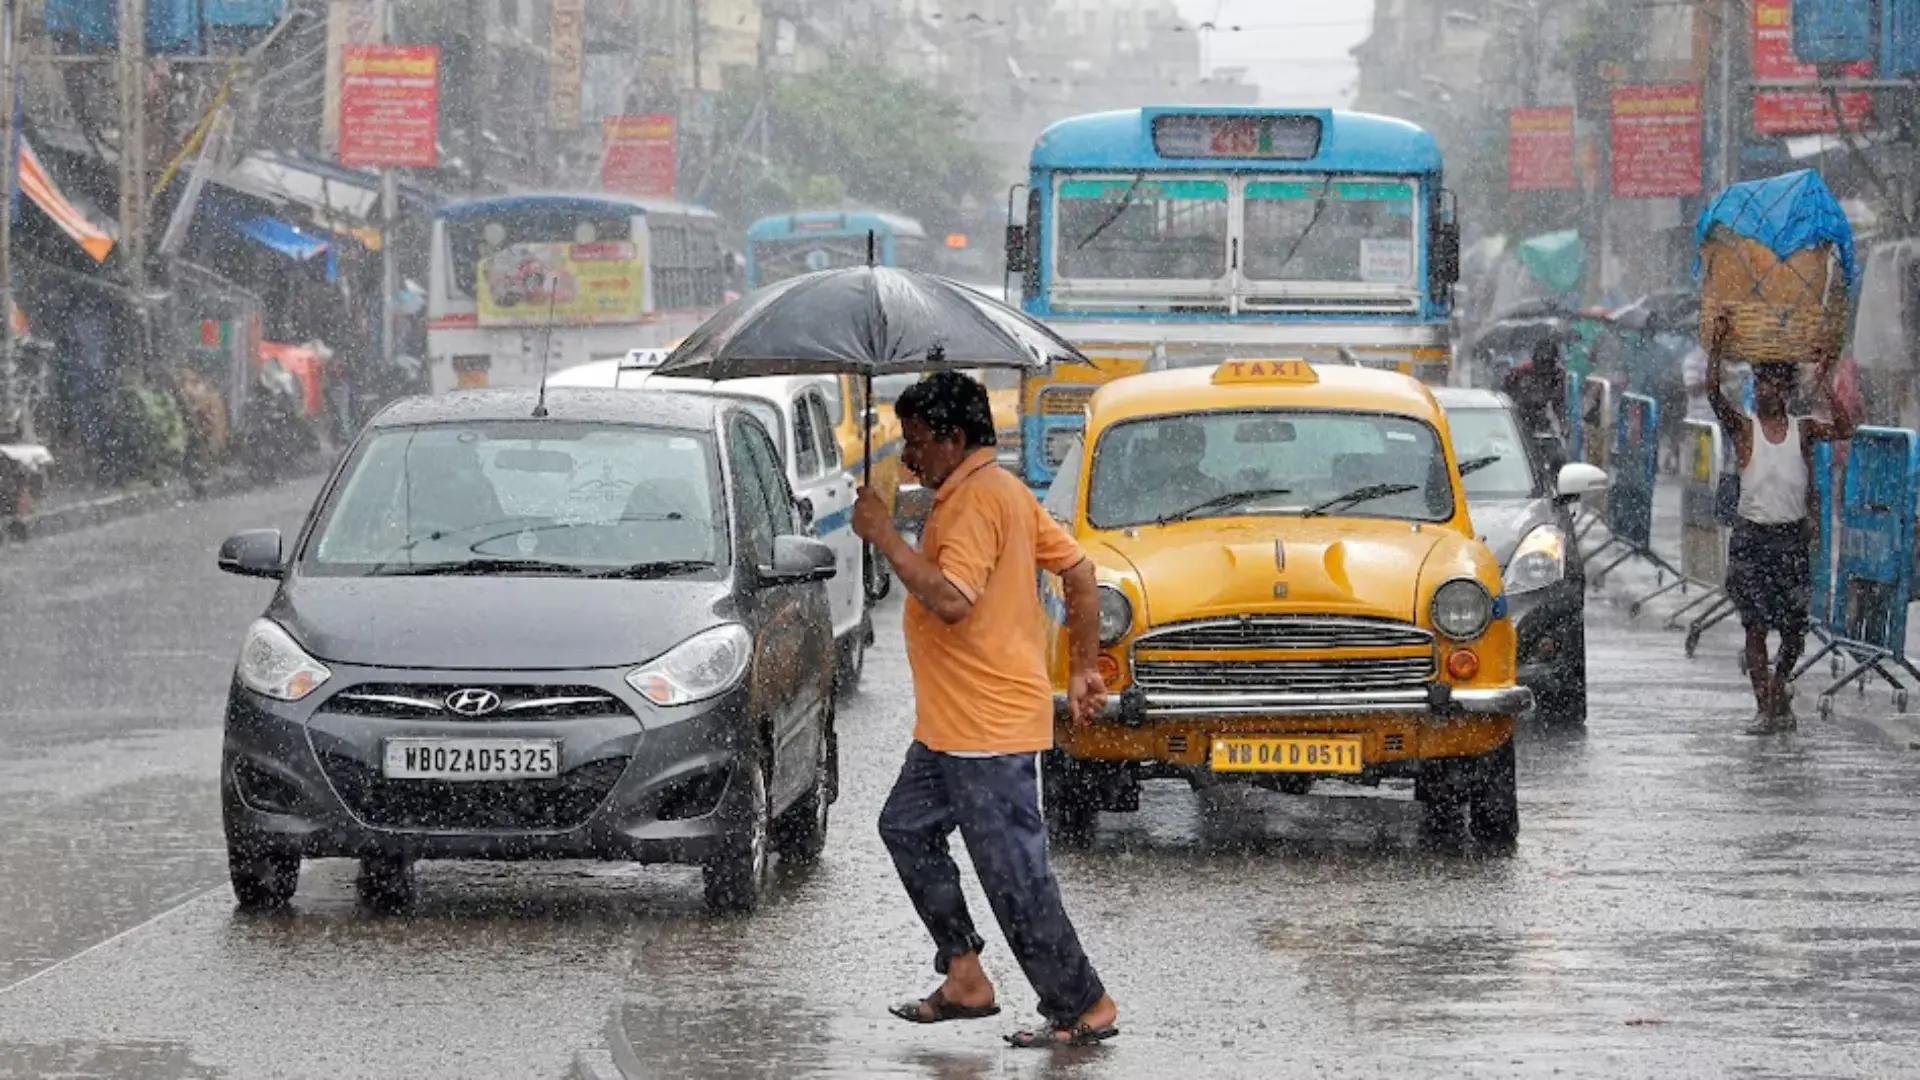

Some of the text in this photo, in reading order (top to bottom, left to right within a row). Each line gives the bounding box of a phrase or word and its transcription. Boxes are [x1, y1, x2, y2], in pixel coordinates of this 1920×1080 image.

[631, 352, 669, 363] TA
[1229, 361, 1302, 377] TAXI
[405, 746, 552, 773] WB02AD5325
[1228, 743, 1356, 766] WB 04 D 8511
